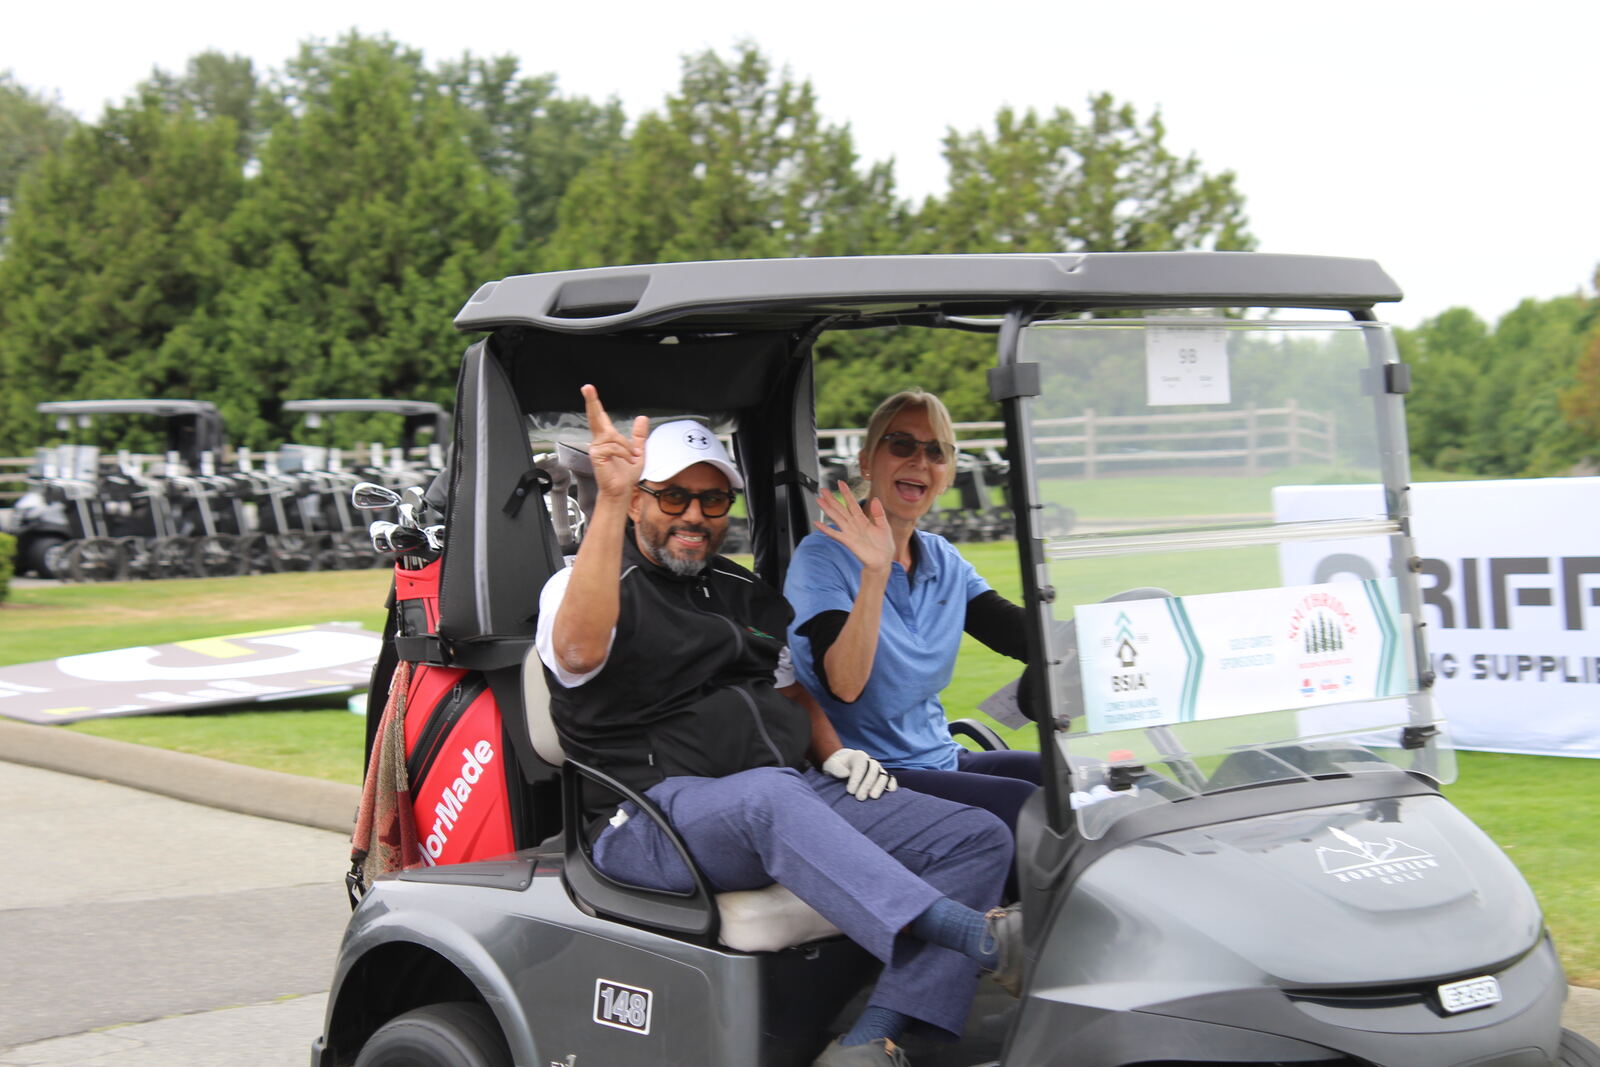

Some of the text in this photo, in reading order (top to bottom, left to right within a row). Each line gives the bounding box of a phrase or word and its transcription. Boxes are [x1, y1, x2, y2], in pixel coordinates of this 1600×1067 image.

[1110, 674, 1147, 693] BSIA
[417, 739, 494, 868] lorMade
[1334, 858, 1440, 883] NORTHVIEW
[1380, 871, 1425, 885] GOLF
[600, 986, 647, 1027] 148
